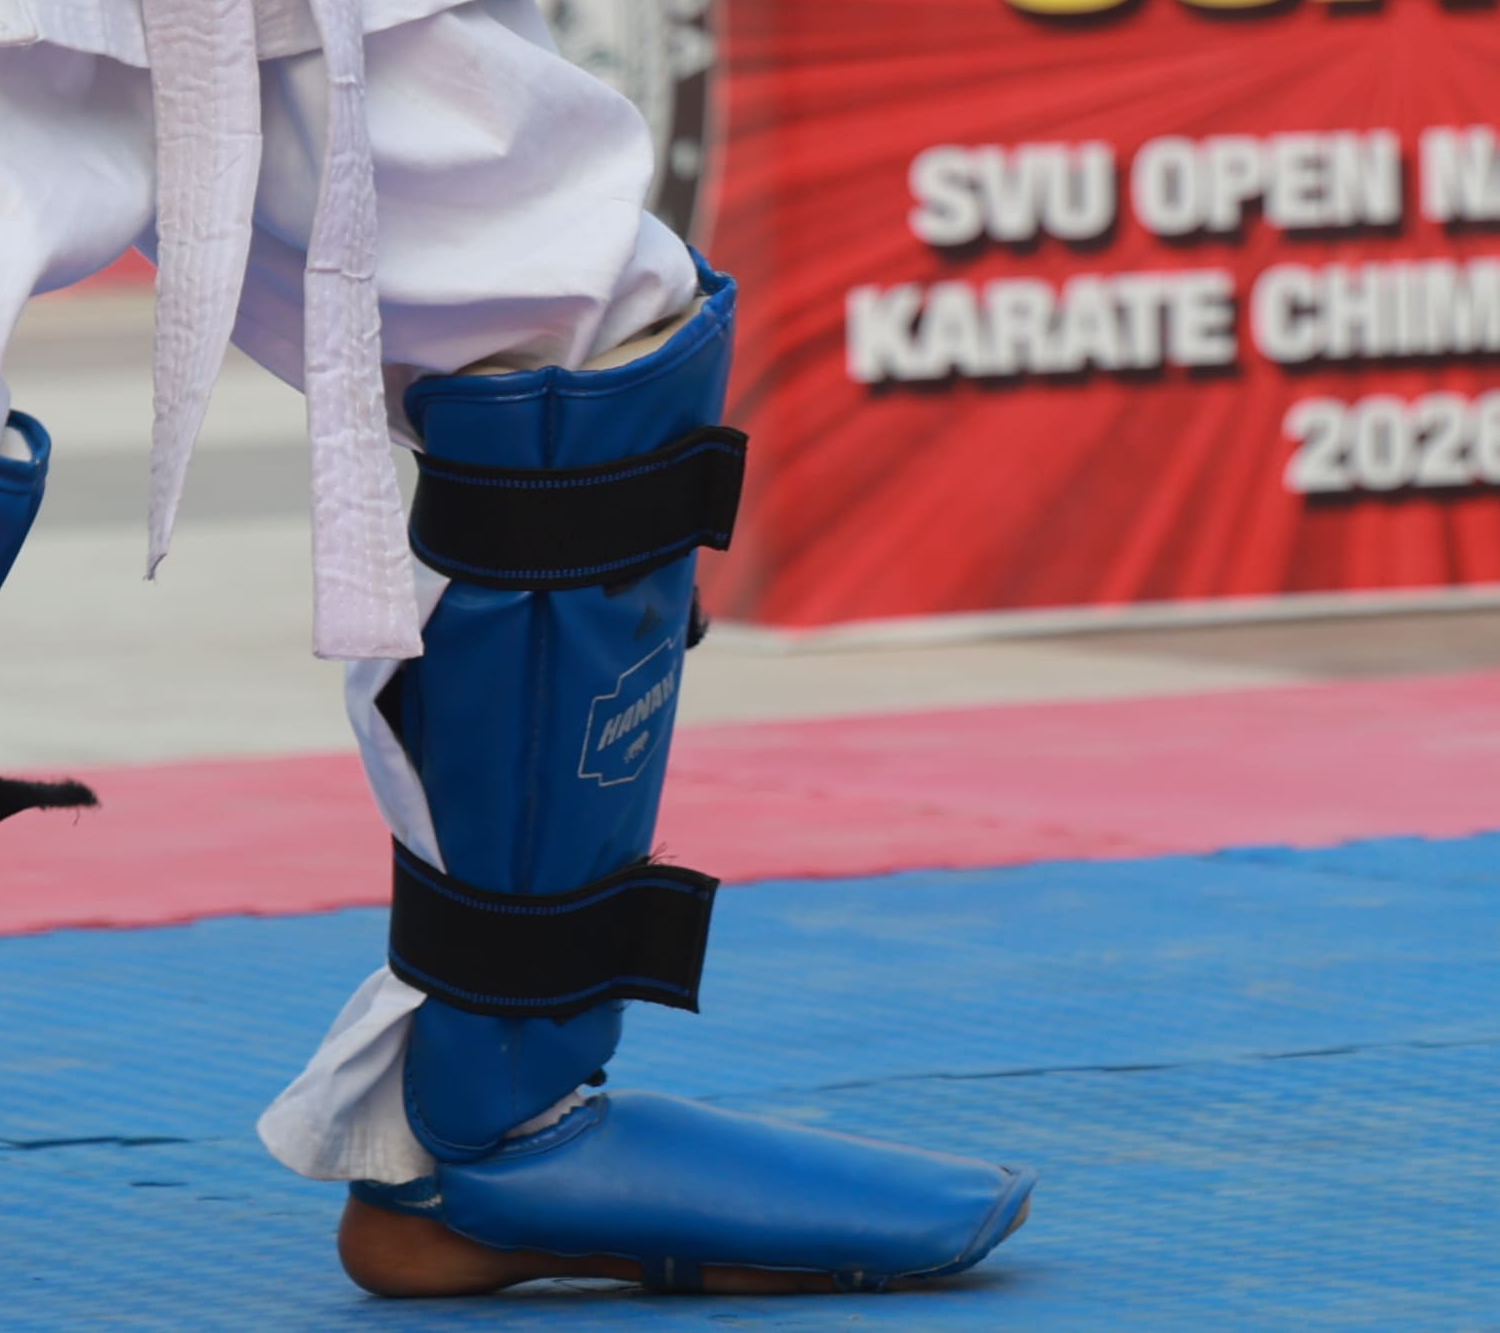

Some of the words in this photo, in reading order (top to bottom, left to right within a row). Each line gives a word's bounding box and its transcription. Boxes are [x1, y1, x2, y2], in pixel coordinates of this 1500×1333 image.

[909, 141, 1117, 247] SVU
[1131, 130, 1401, 237] OPEN
[845, 269, 1237, 383] KARATE
